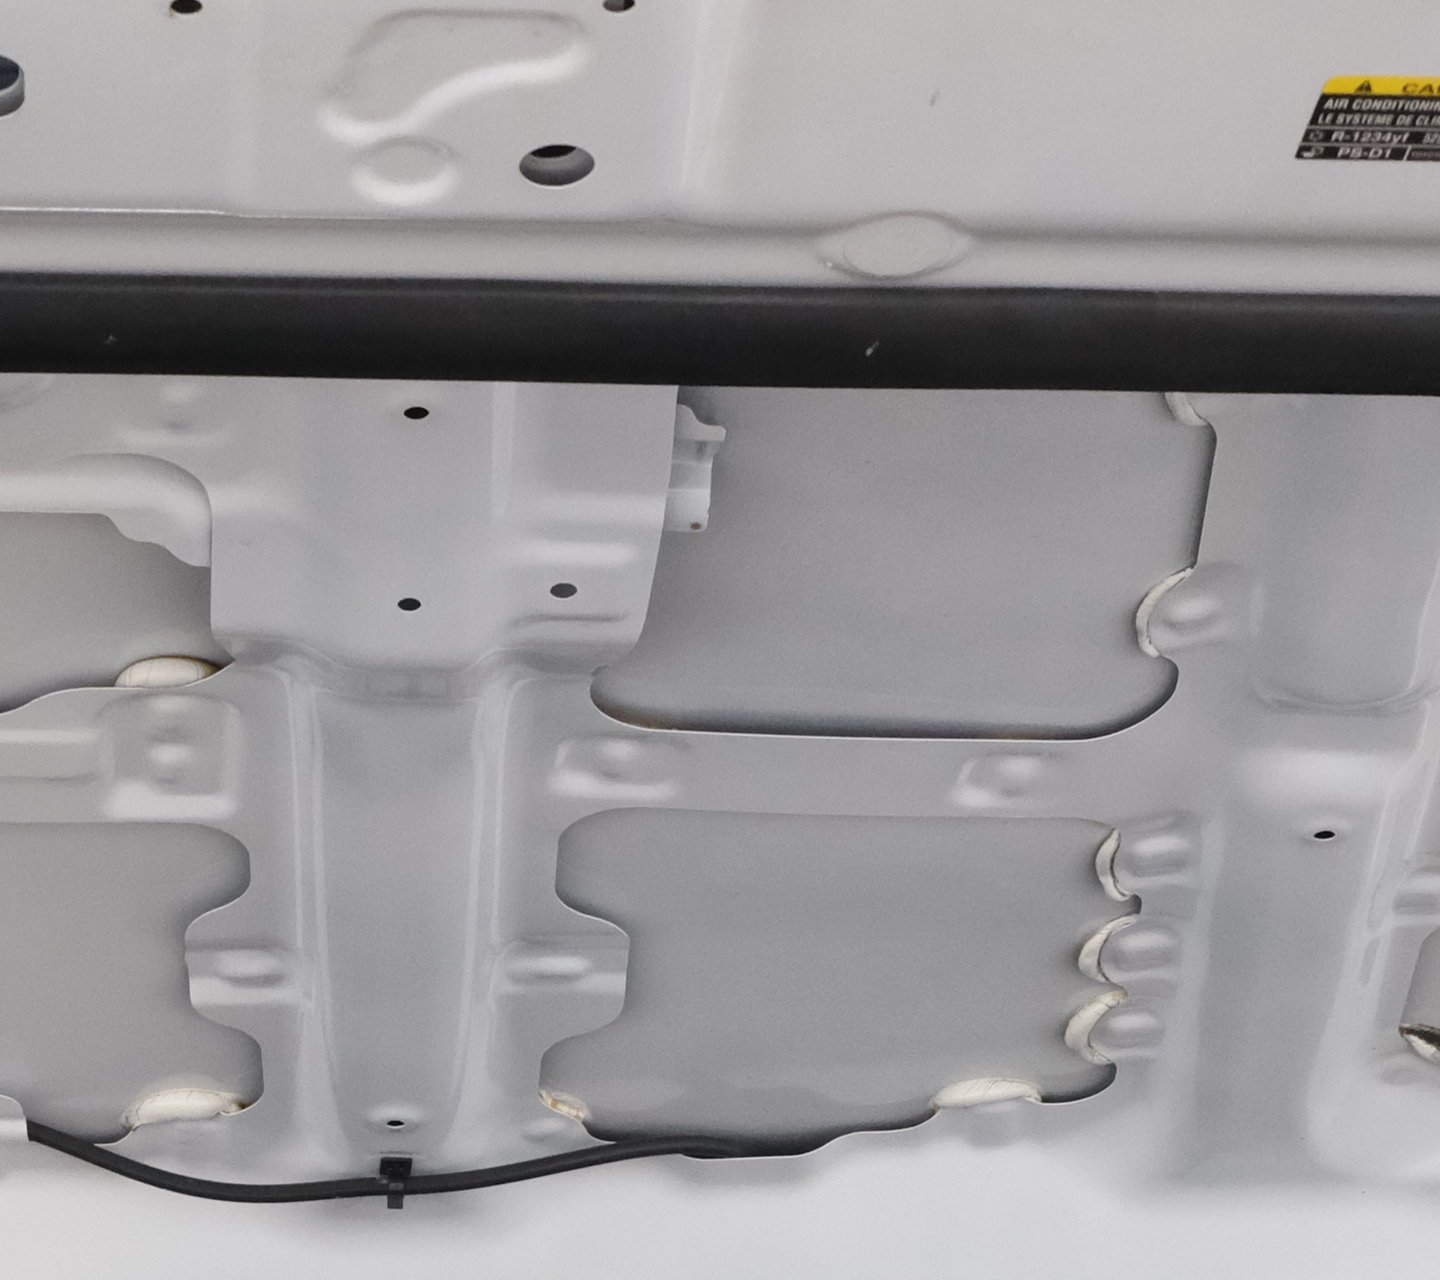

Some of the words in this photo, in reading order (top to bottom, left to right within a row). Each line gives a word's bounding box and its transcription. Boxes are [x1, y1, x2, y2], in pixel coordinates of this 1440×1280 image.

[1323, 98, 1350, 110] AIR
[1317, 113, 1334, 124] LE
[1396, 114, 1413, 126] DE
